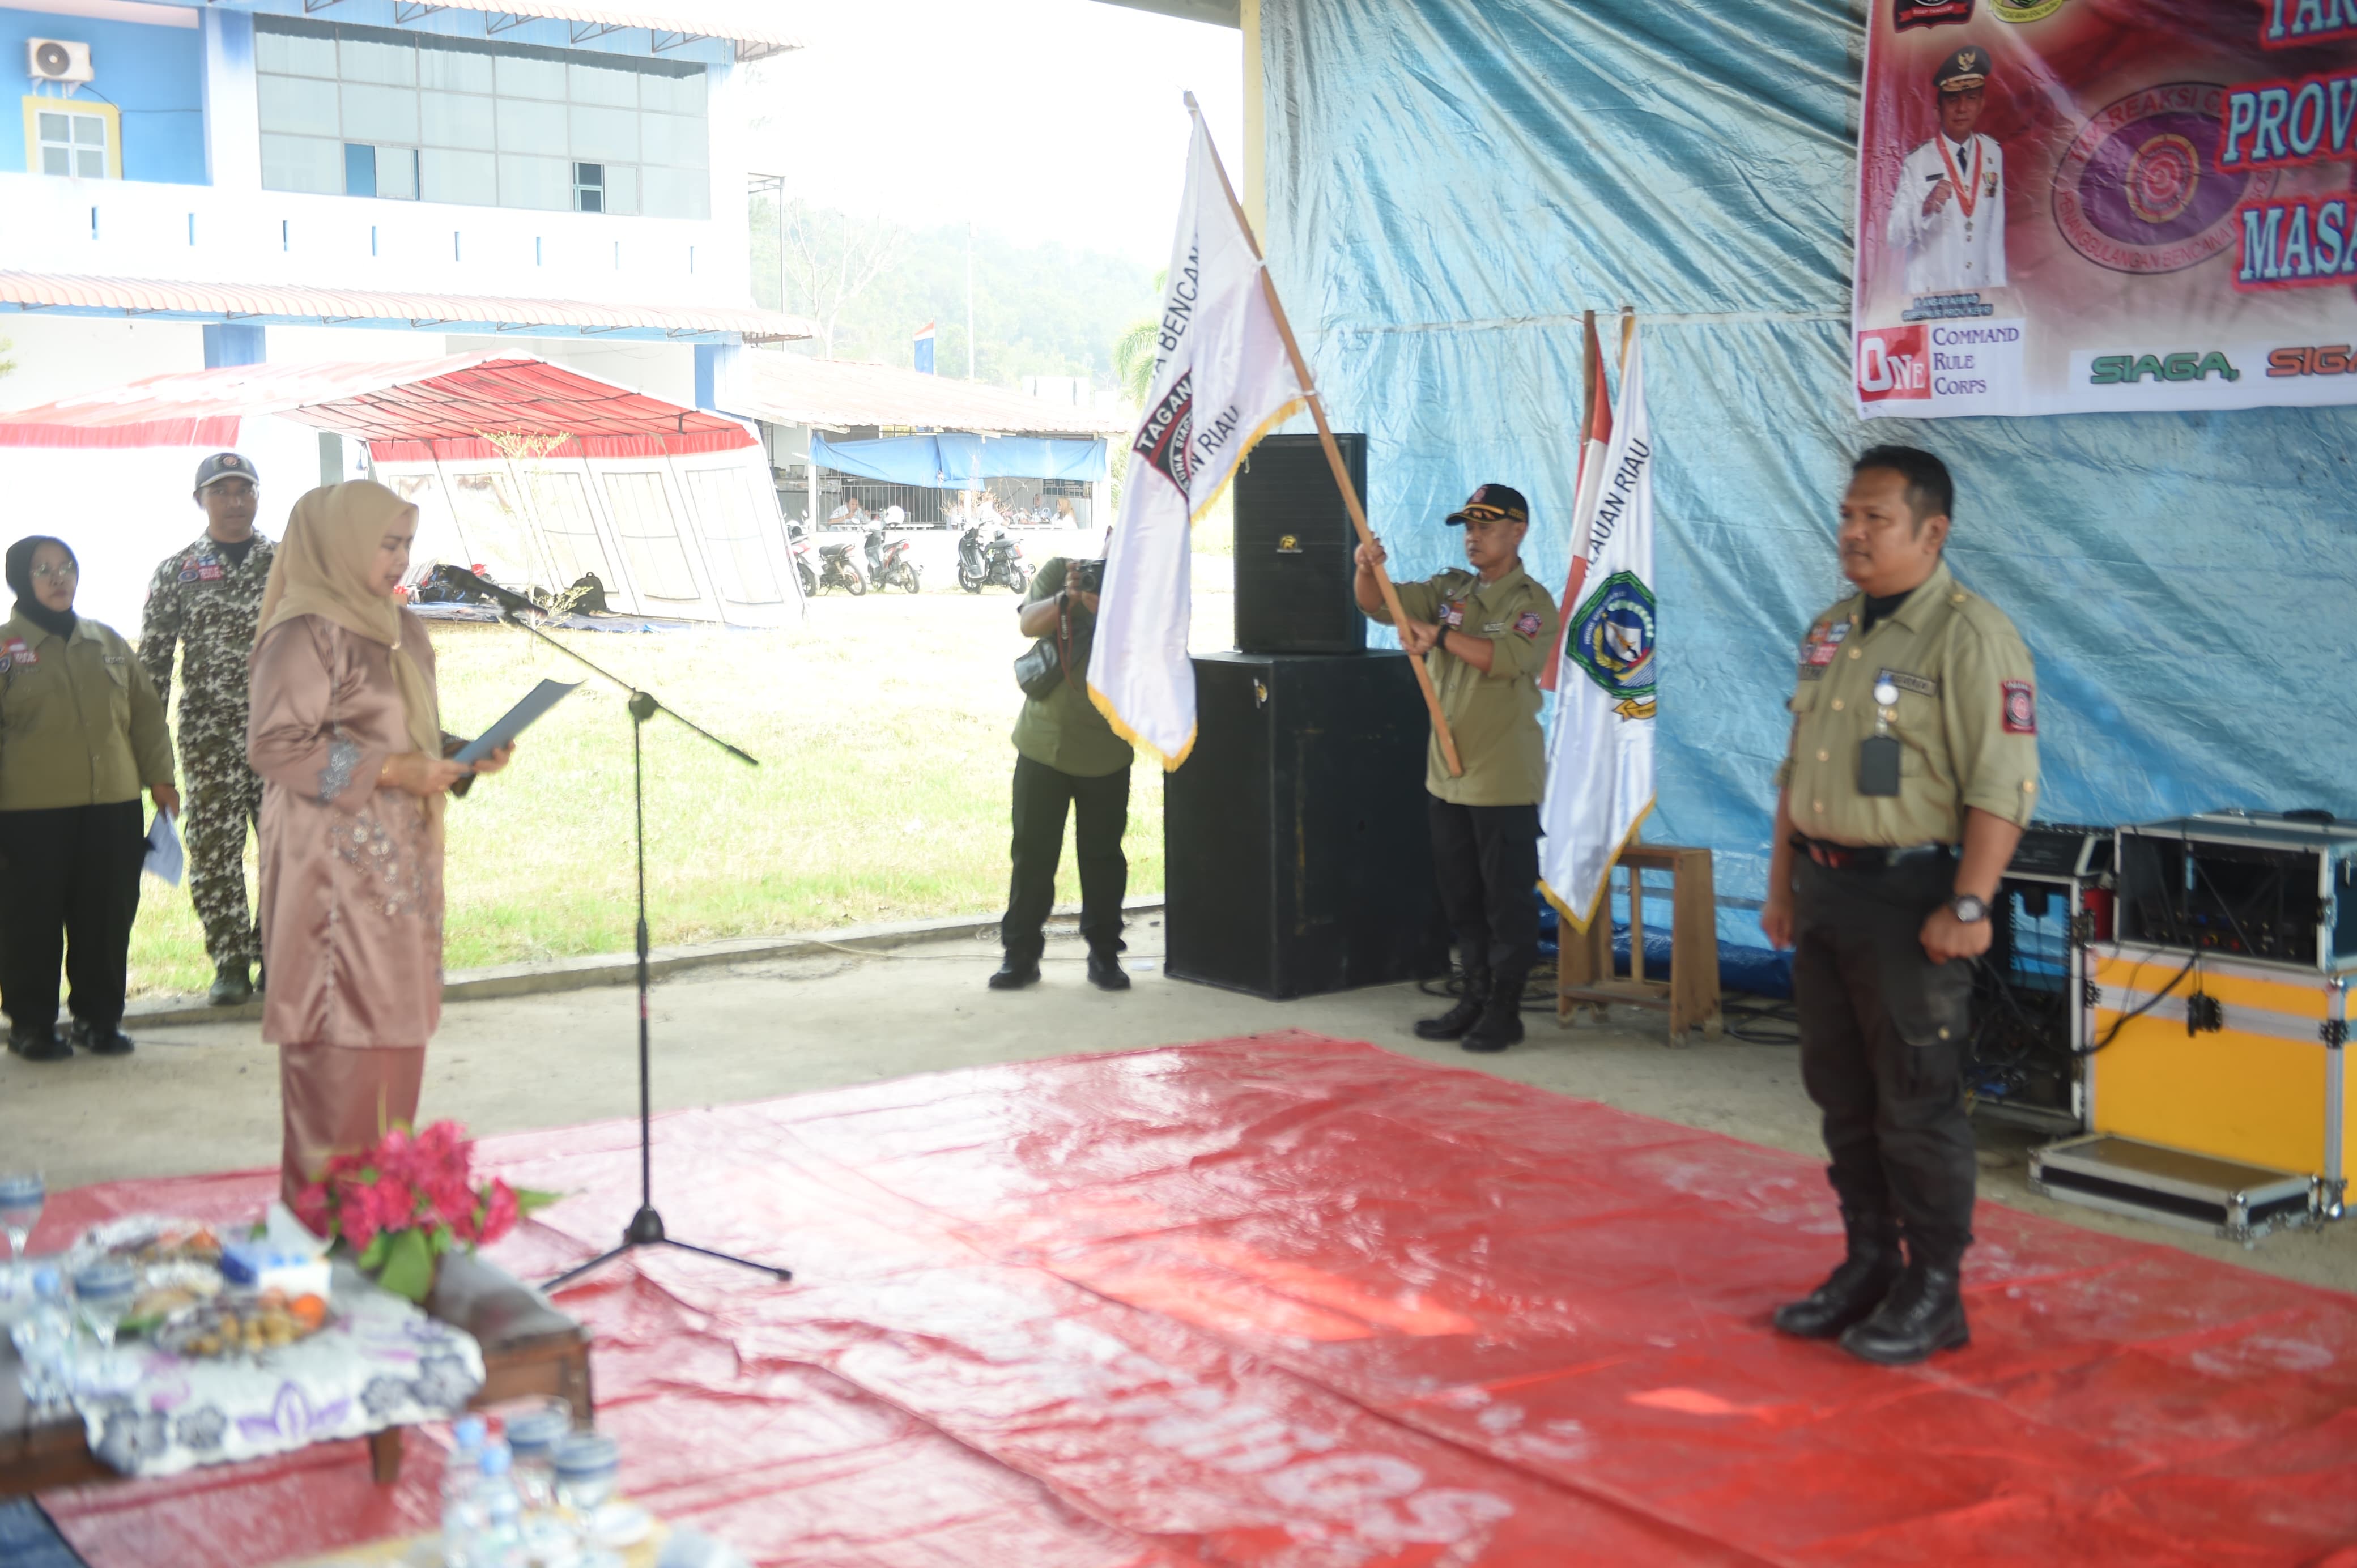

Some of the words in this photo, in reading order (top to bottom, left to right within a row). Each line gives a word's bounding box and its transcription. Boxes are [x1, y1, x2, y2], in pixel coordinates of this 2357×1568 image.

[2106, 87, 2198, 128] REAKSI
[1158, 237, 1199, 352] BENCAN
[2266, 344, 2357, 377] SIG
[1137, 377, 1192, 449] TAGAN
[1197, 405, 1240, 455] RIAU
[1614, 438, 1650, 493] RIAU
